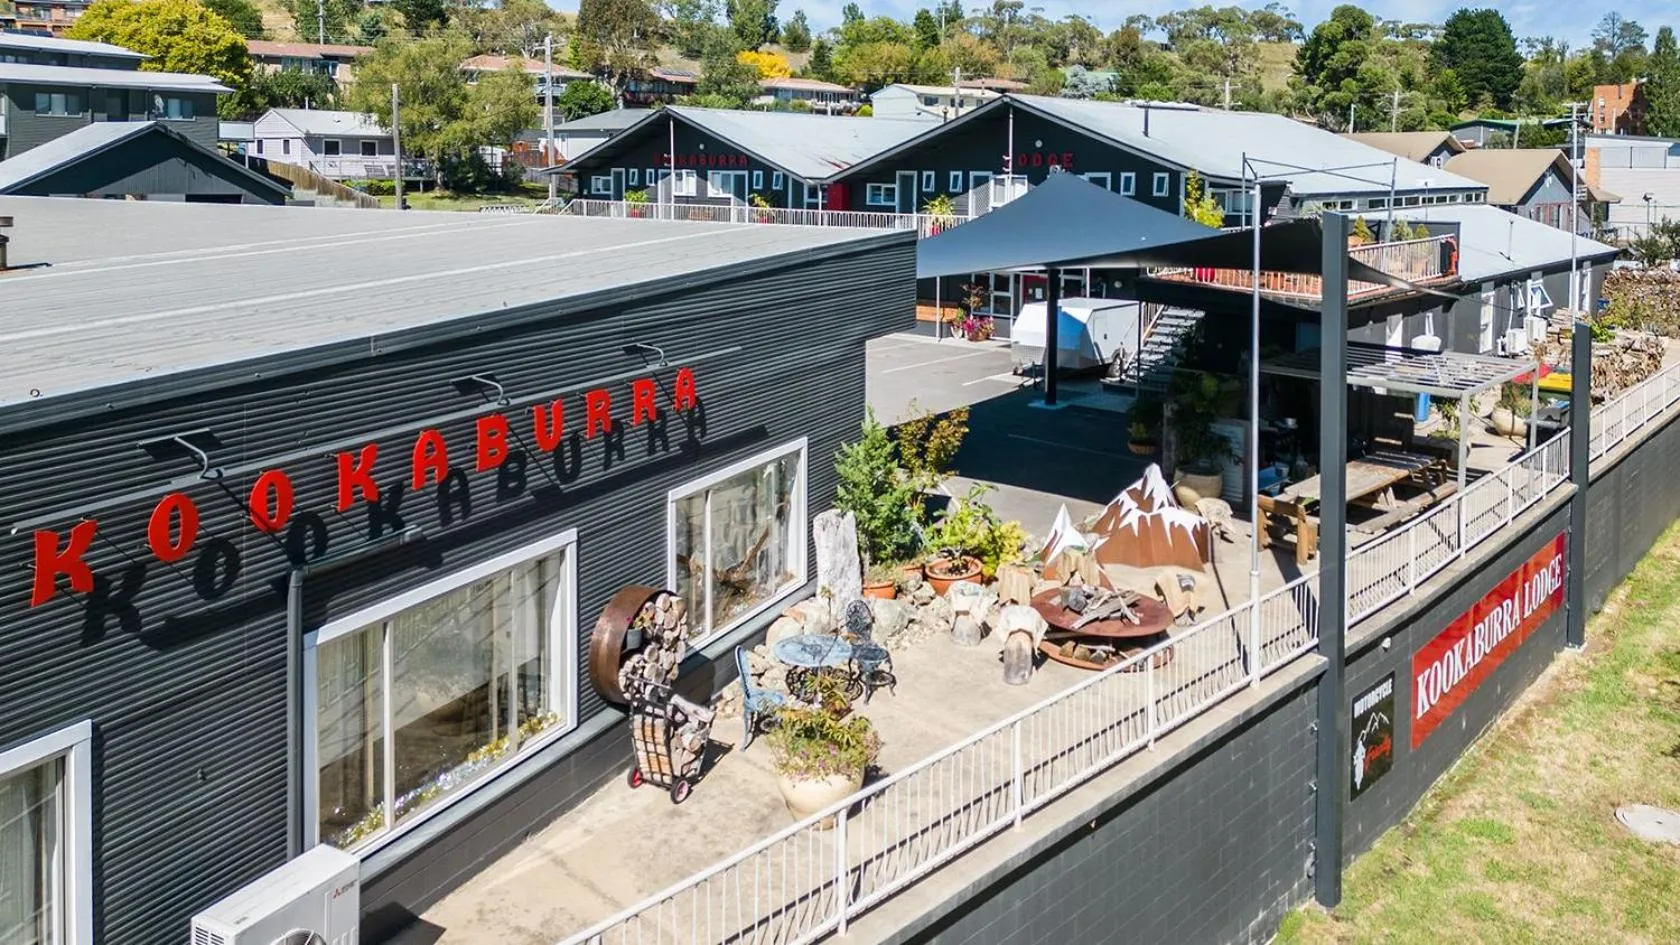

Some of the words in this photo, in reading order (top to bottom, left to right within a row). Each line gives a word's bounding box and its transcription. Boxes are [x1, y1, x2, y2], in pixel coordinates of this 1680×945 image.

[30, 367, 698, 607] KOOKABURRA
[1416, 591, 1521, 720] KOOKABURRA
[1523, 553, 1562, 619] LODGE
